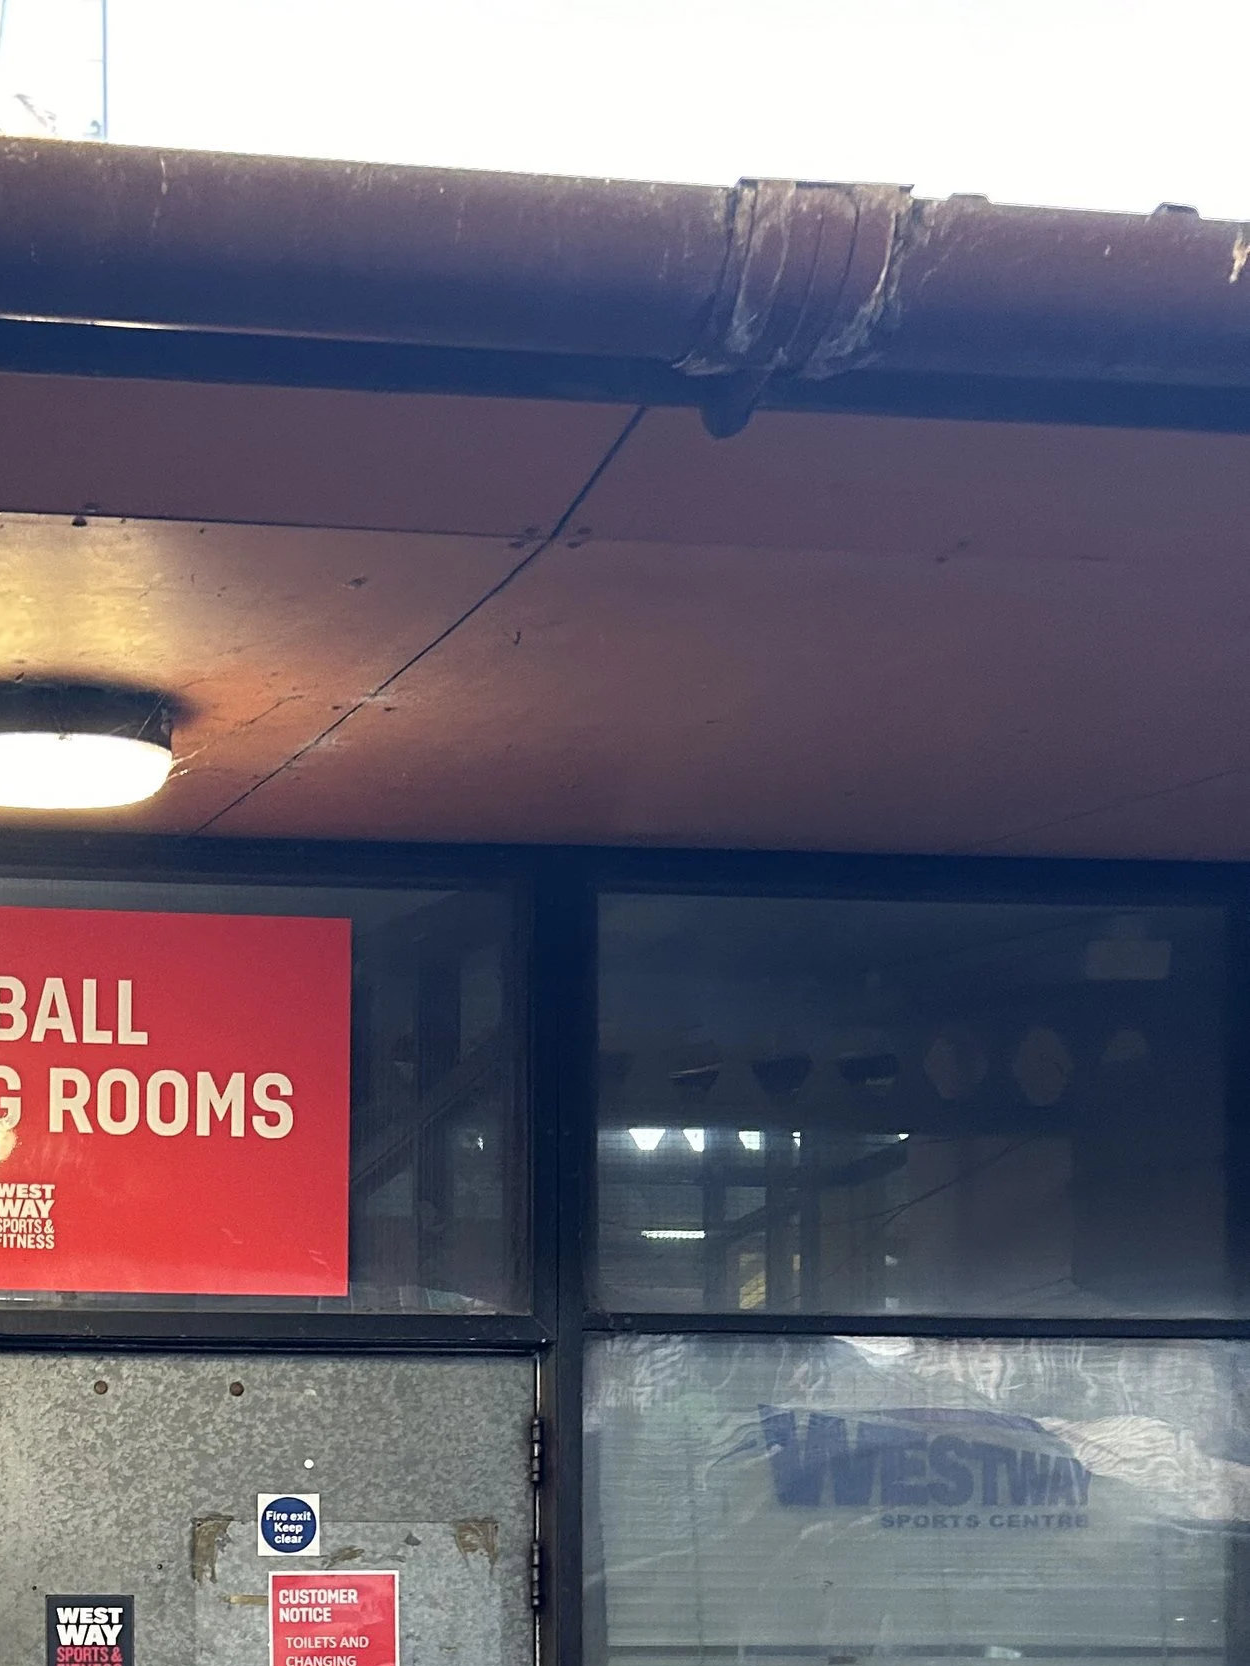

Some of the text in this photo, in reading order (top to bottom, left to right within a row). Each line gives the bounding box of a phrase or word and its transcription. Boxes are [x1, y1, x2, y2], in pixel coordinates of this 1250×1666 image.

[48, 1067, 294, 1139] ROOMS
[43, 1218, 55, 1234] &
[265, 1510, 312, 1521] Fire exit
[880, 1511, 1090, 1530] SPORTS CENTRE
[273, 1522, 304, 1534] Keep
[274, 1533, 304, 1544] clear
[278, 1589, 358, 1604] CUSTOMER
[56, 1607, 124, 1625] WEST
[279, 1607, 332, 1623] NOTICE
[56, 1624, 124, 1646] WAY
[285, 1636, 370, 1649] TOILETS AND
[56, 1646, 123, 1663] SPORTS &
